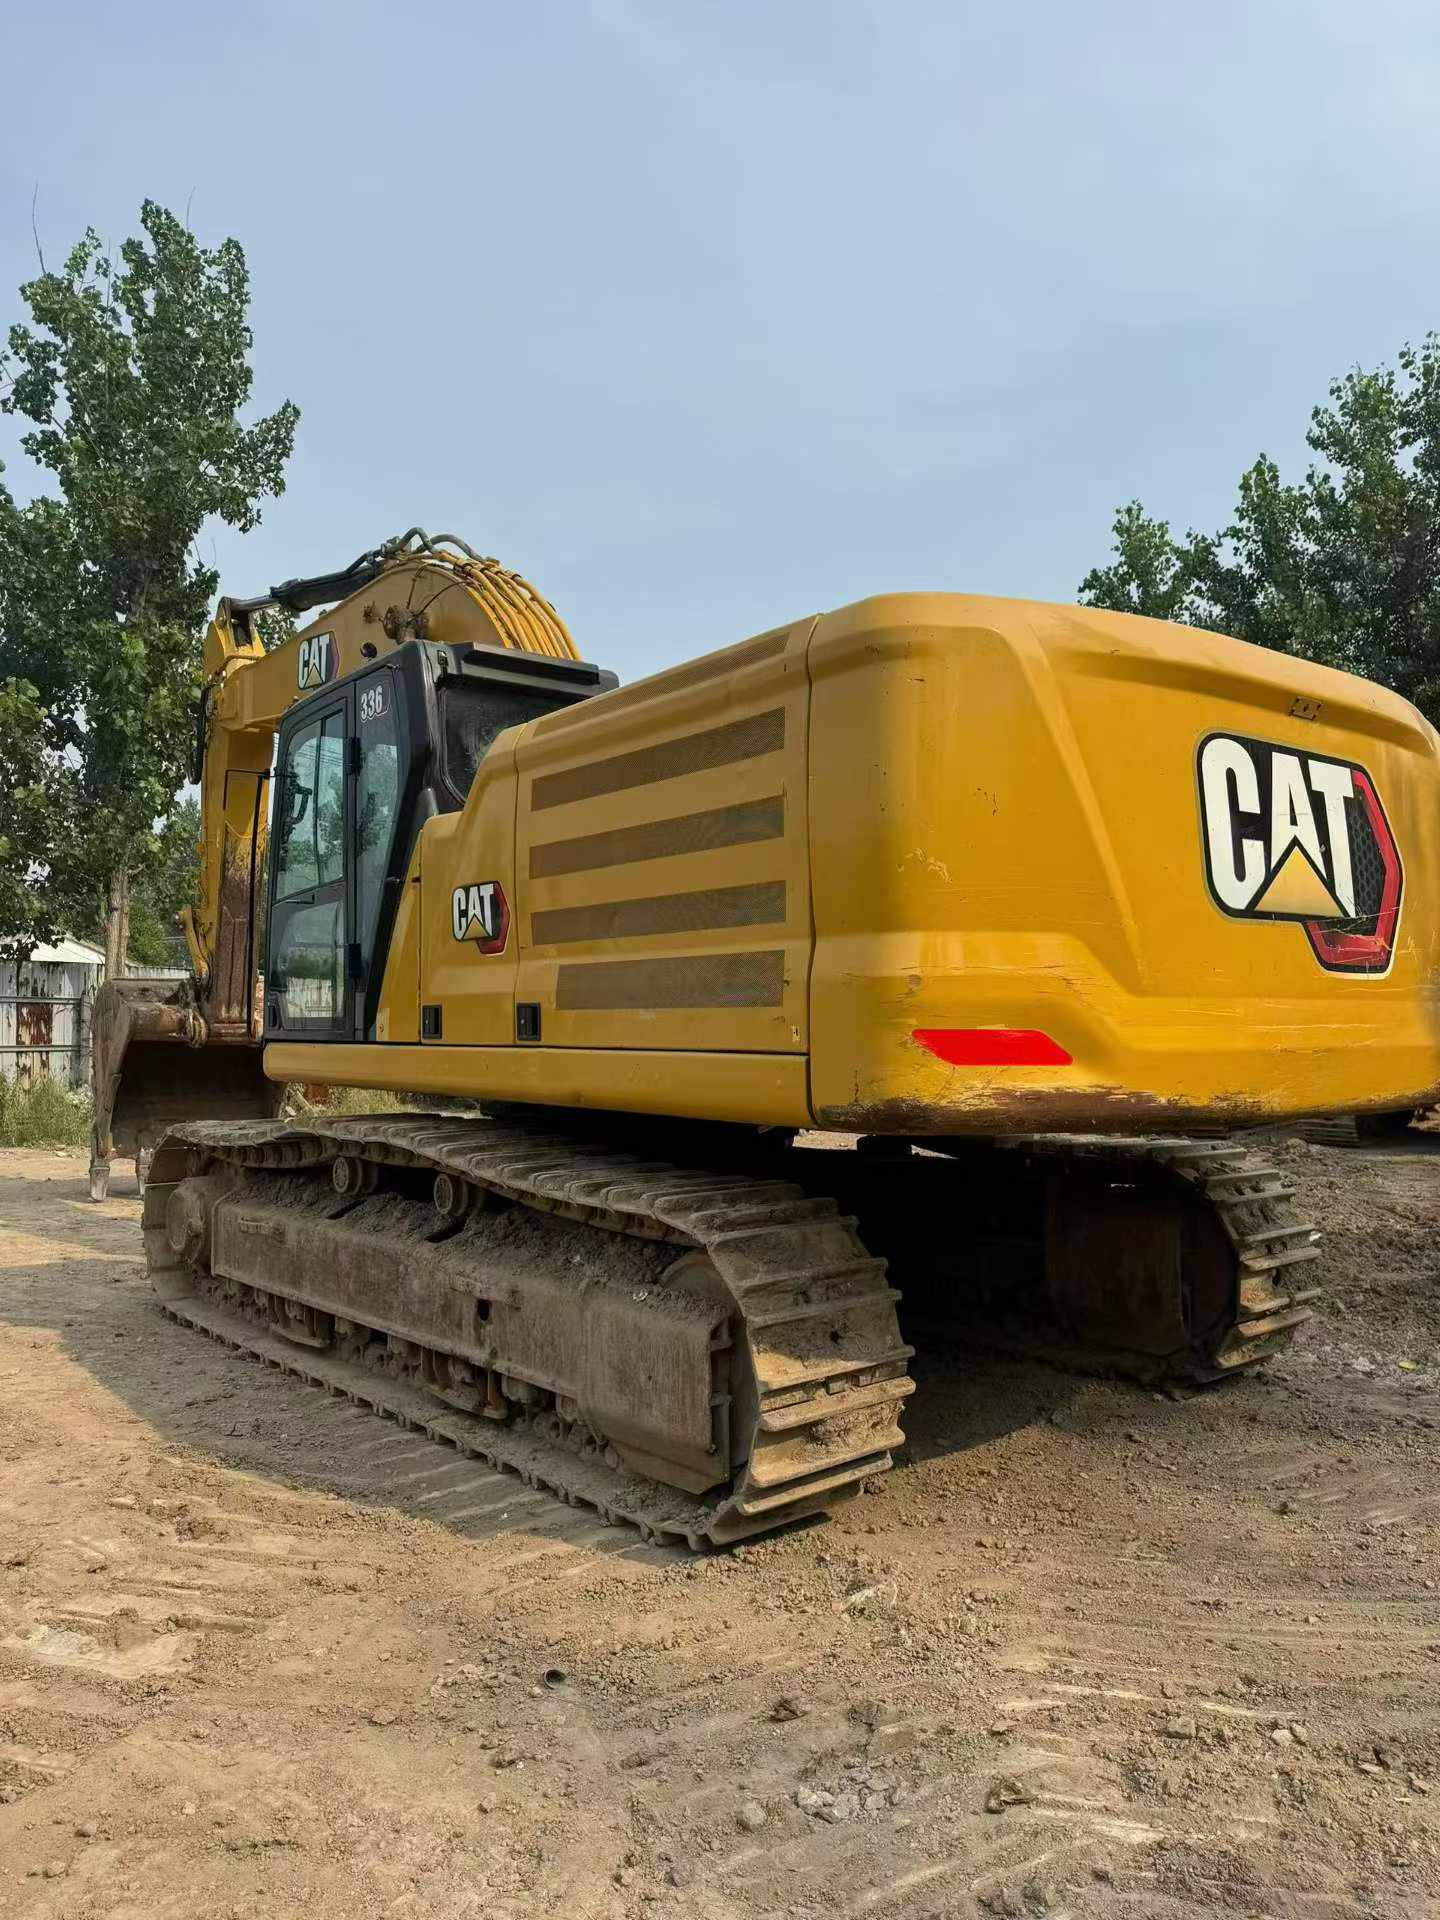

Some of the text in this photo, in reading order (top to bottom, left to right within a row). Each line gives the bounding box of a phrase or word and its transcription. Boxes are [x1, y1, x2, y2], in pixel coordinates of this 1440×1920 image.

[298, 633, 330, 689] CAT
[361, 685, 383, 720] 336
[1201, 738, 1356, 918] CAT
[453, 883, 494, 940] CAT
